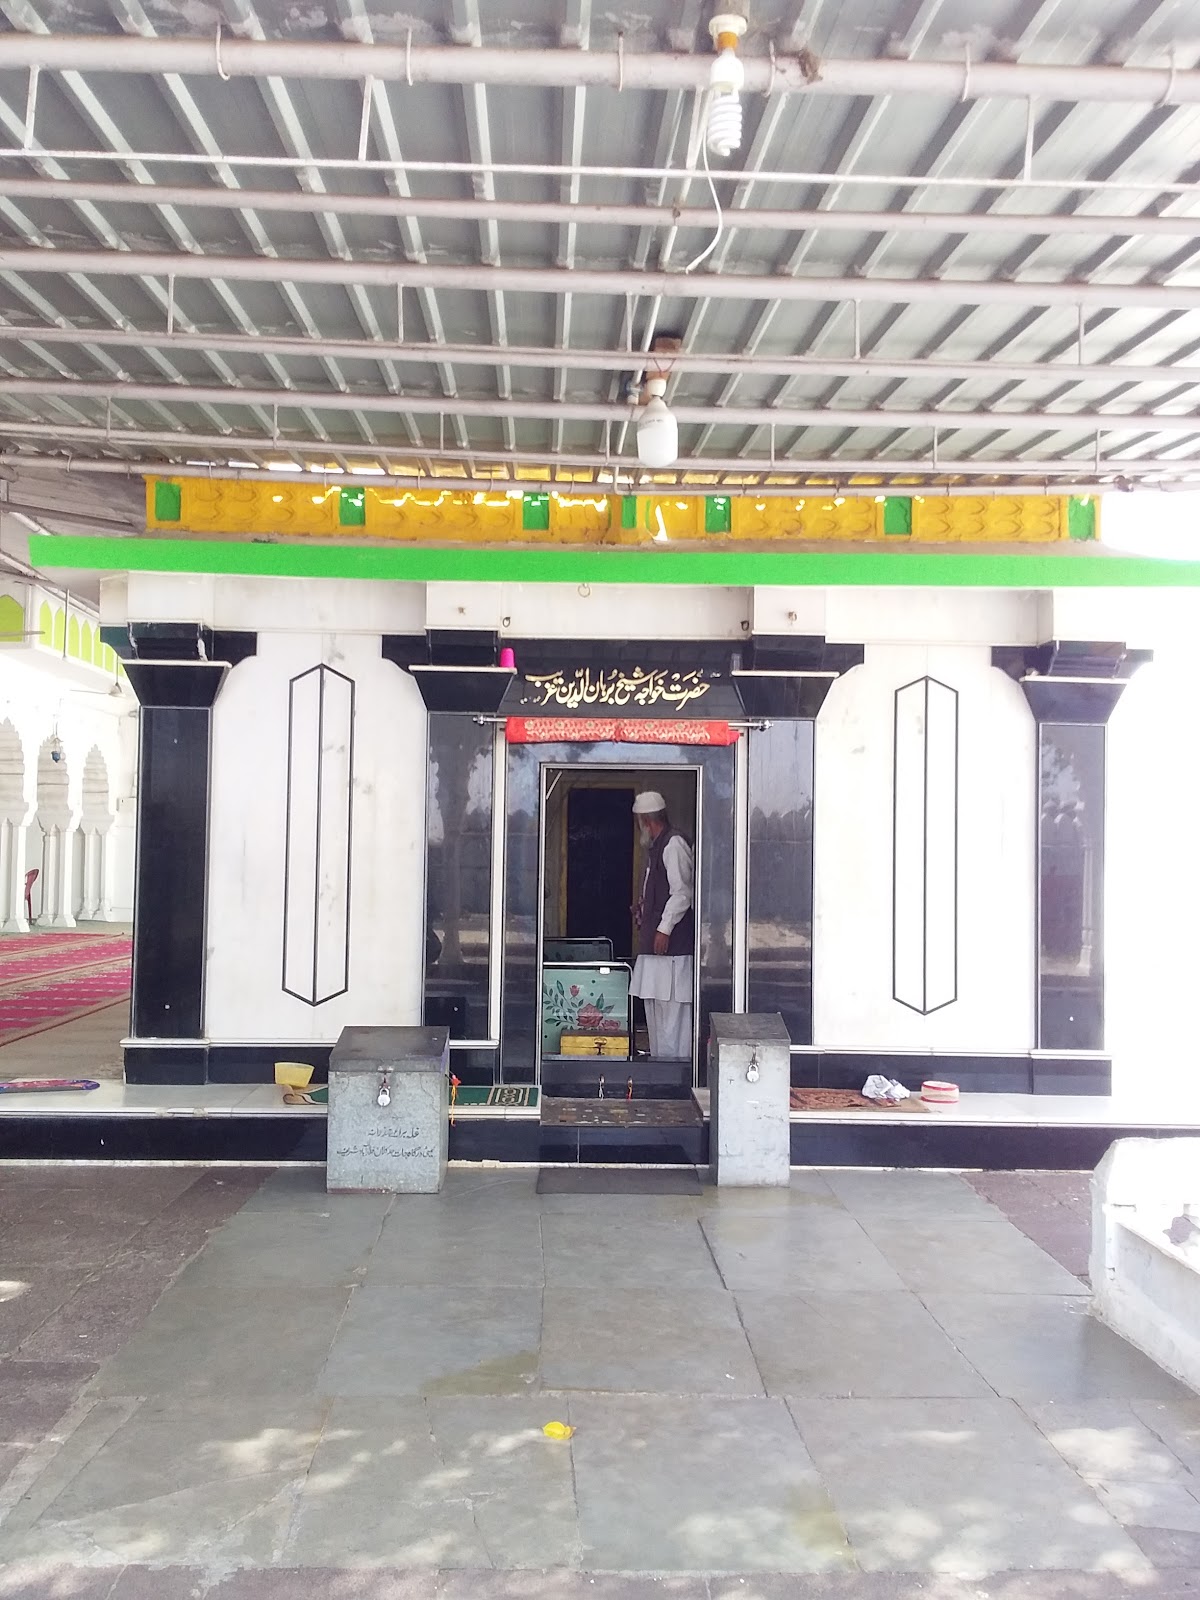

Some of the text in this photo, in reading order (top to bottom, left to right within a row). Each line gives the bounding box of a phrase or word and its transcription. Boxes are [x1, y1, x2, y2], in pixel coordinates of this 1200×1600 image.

[525, 669, 565, 706] غریب
[615, 666, 659, 705] شیخ
[634, 669, 668, 705] خواجہ
[661, 668, 711, 711] حضرت
